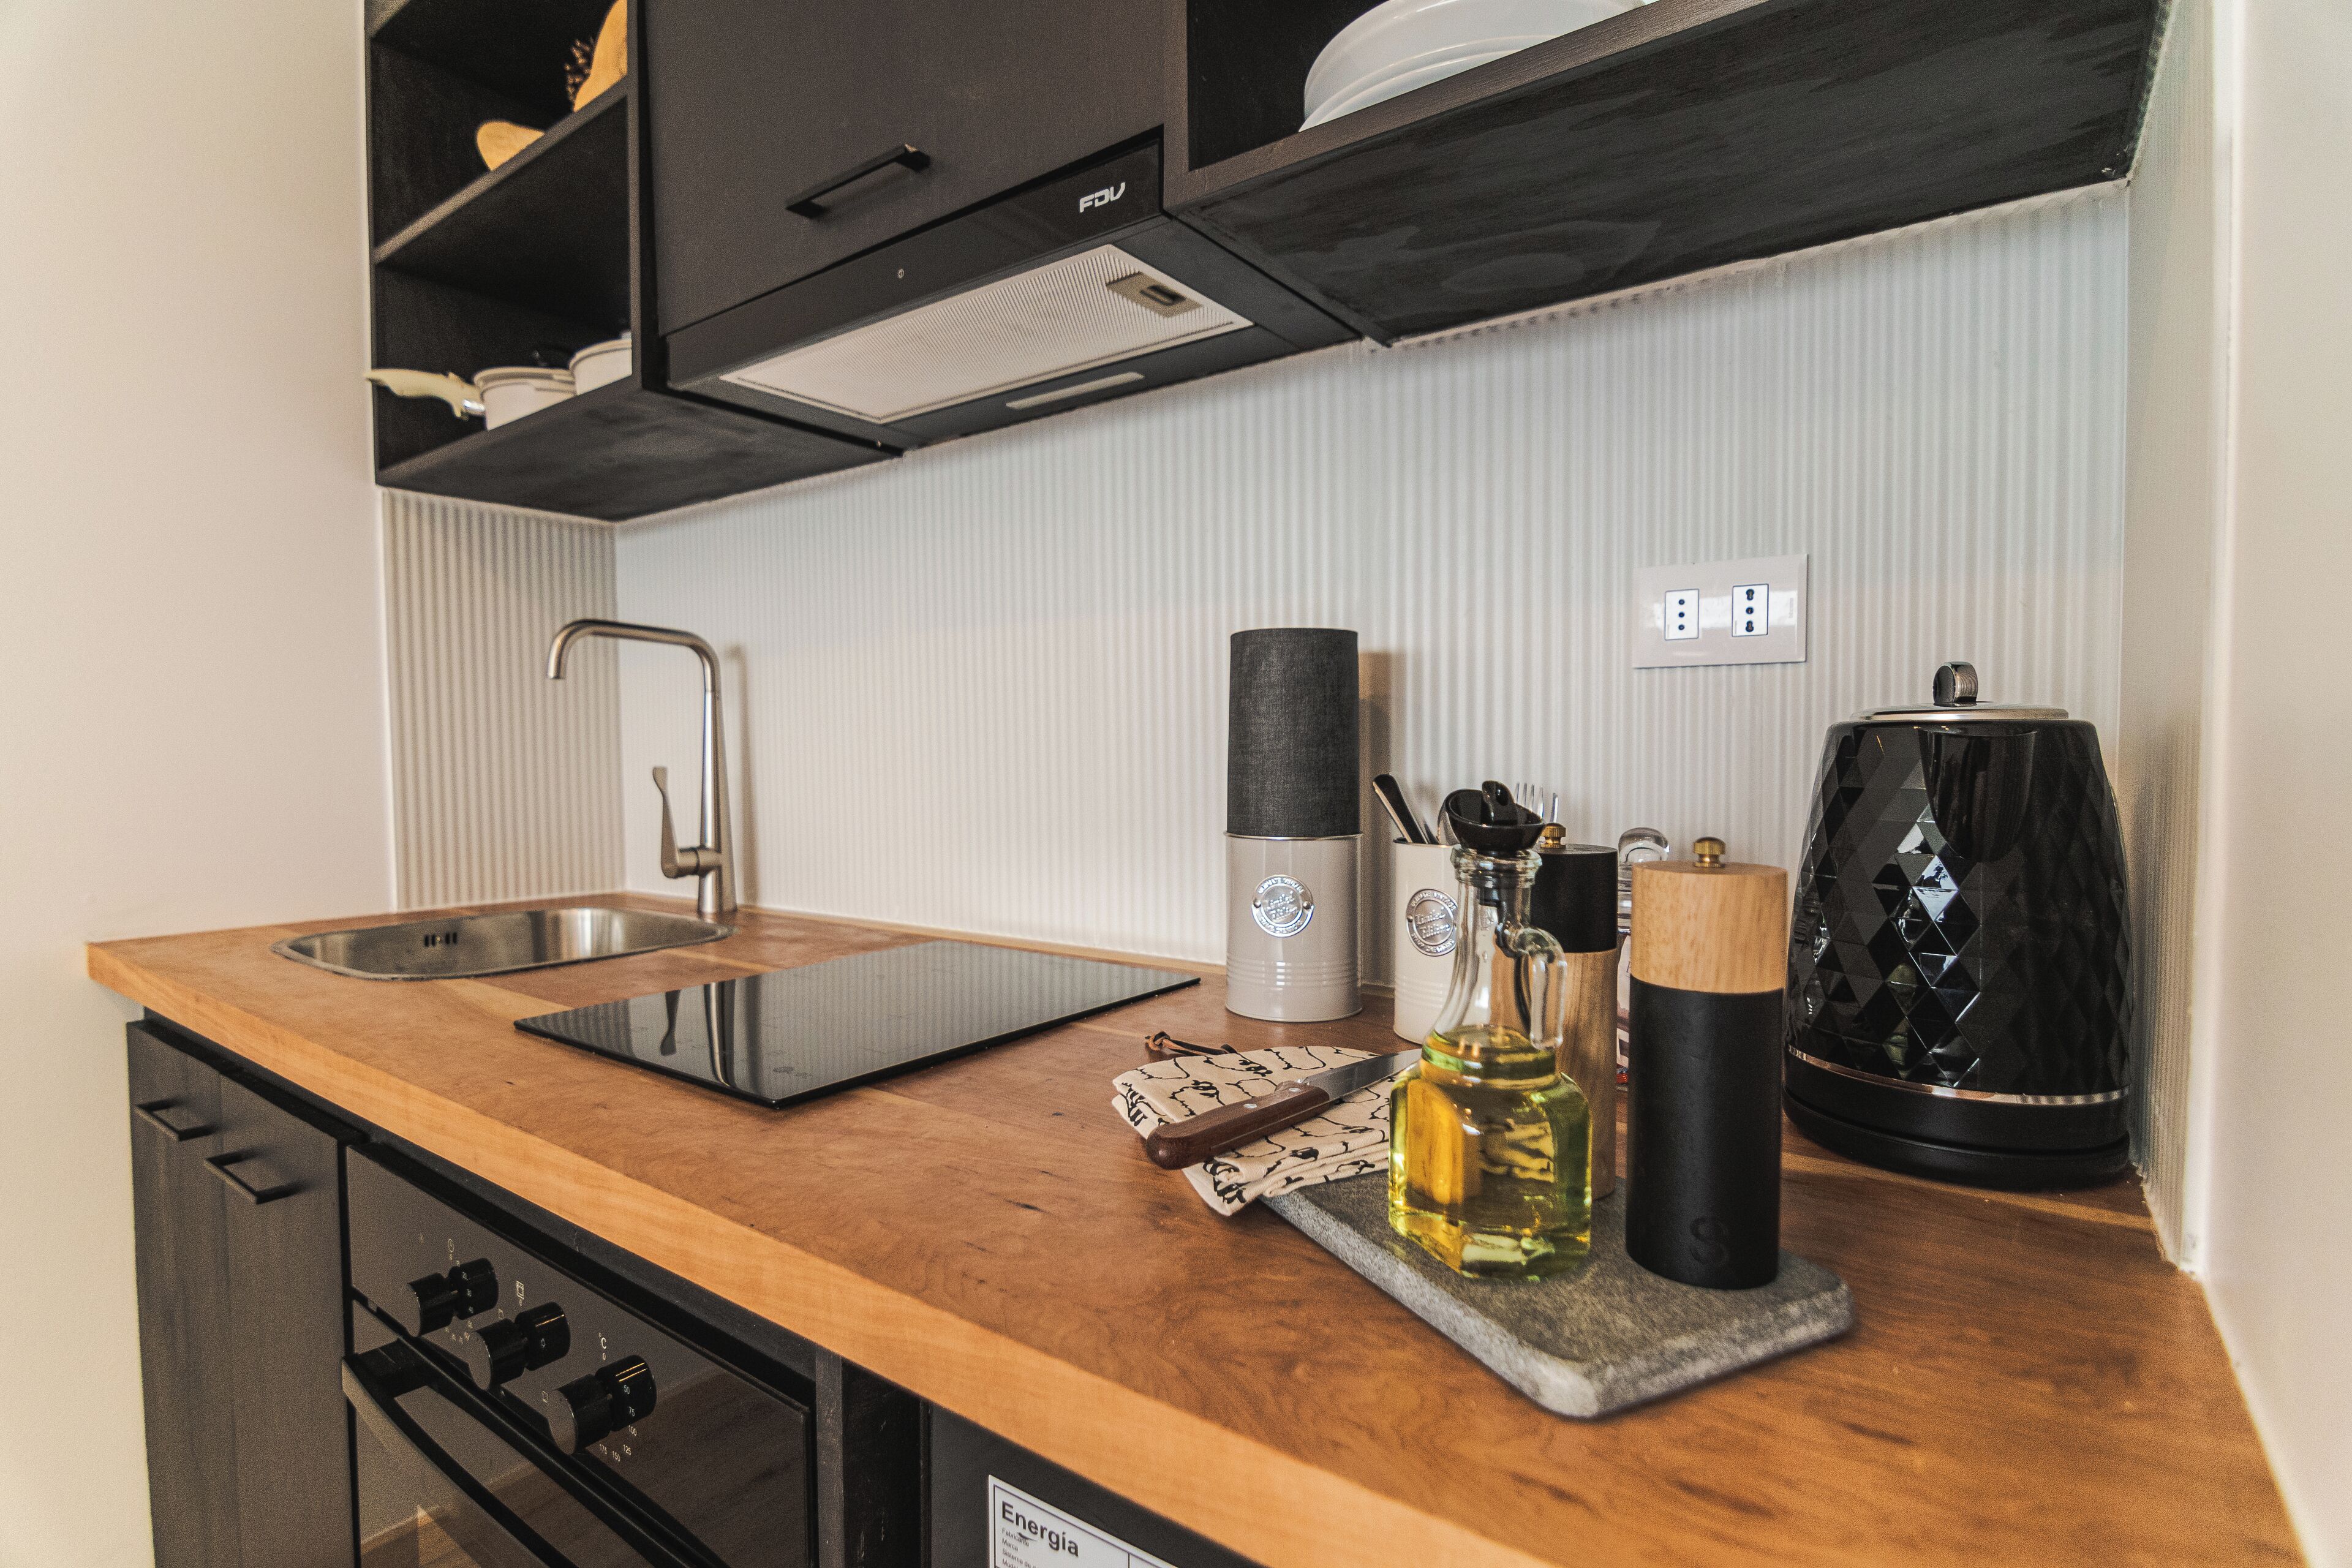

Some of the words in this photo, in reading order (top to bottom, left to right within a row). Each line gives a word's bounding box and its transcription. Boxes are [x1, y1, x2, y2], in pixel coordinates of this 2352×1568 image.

[1080, 182, 1126, 213] FDV
[624, 1384, 630, 1395] 50
[629, 1406, 636, 1417] 75
[628, 1425, 637, 1436] 100
[599, 1444, 608, 1455] 175
[623, 1444, 631, 1455] 125
[612, 1450, 620, 1462] 150
